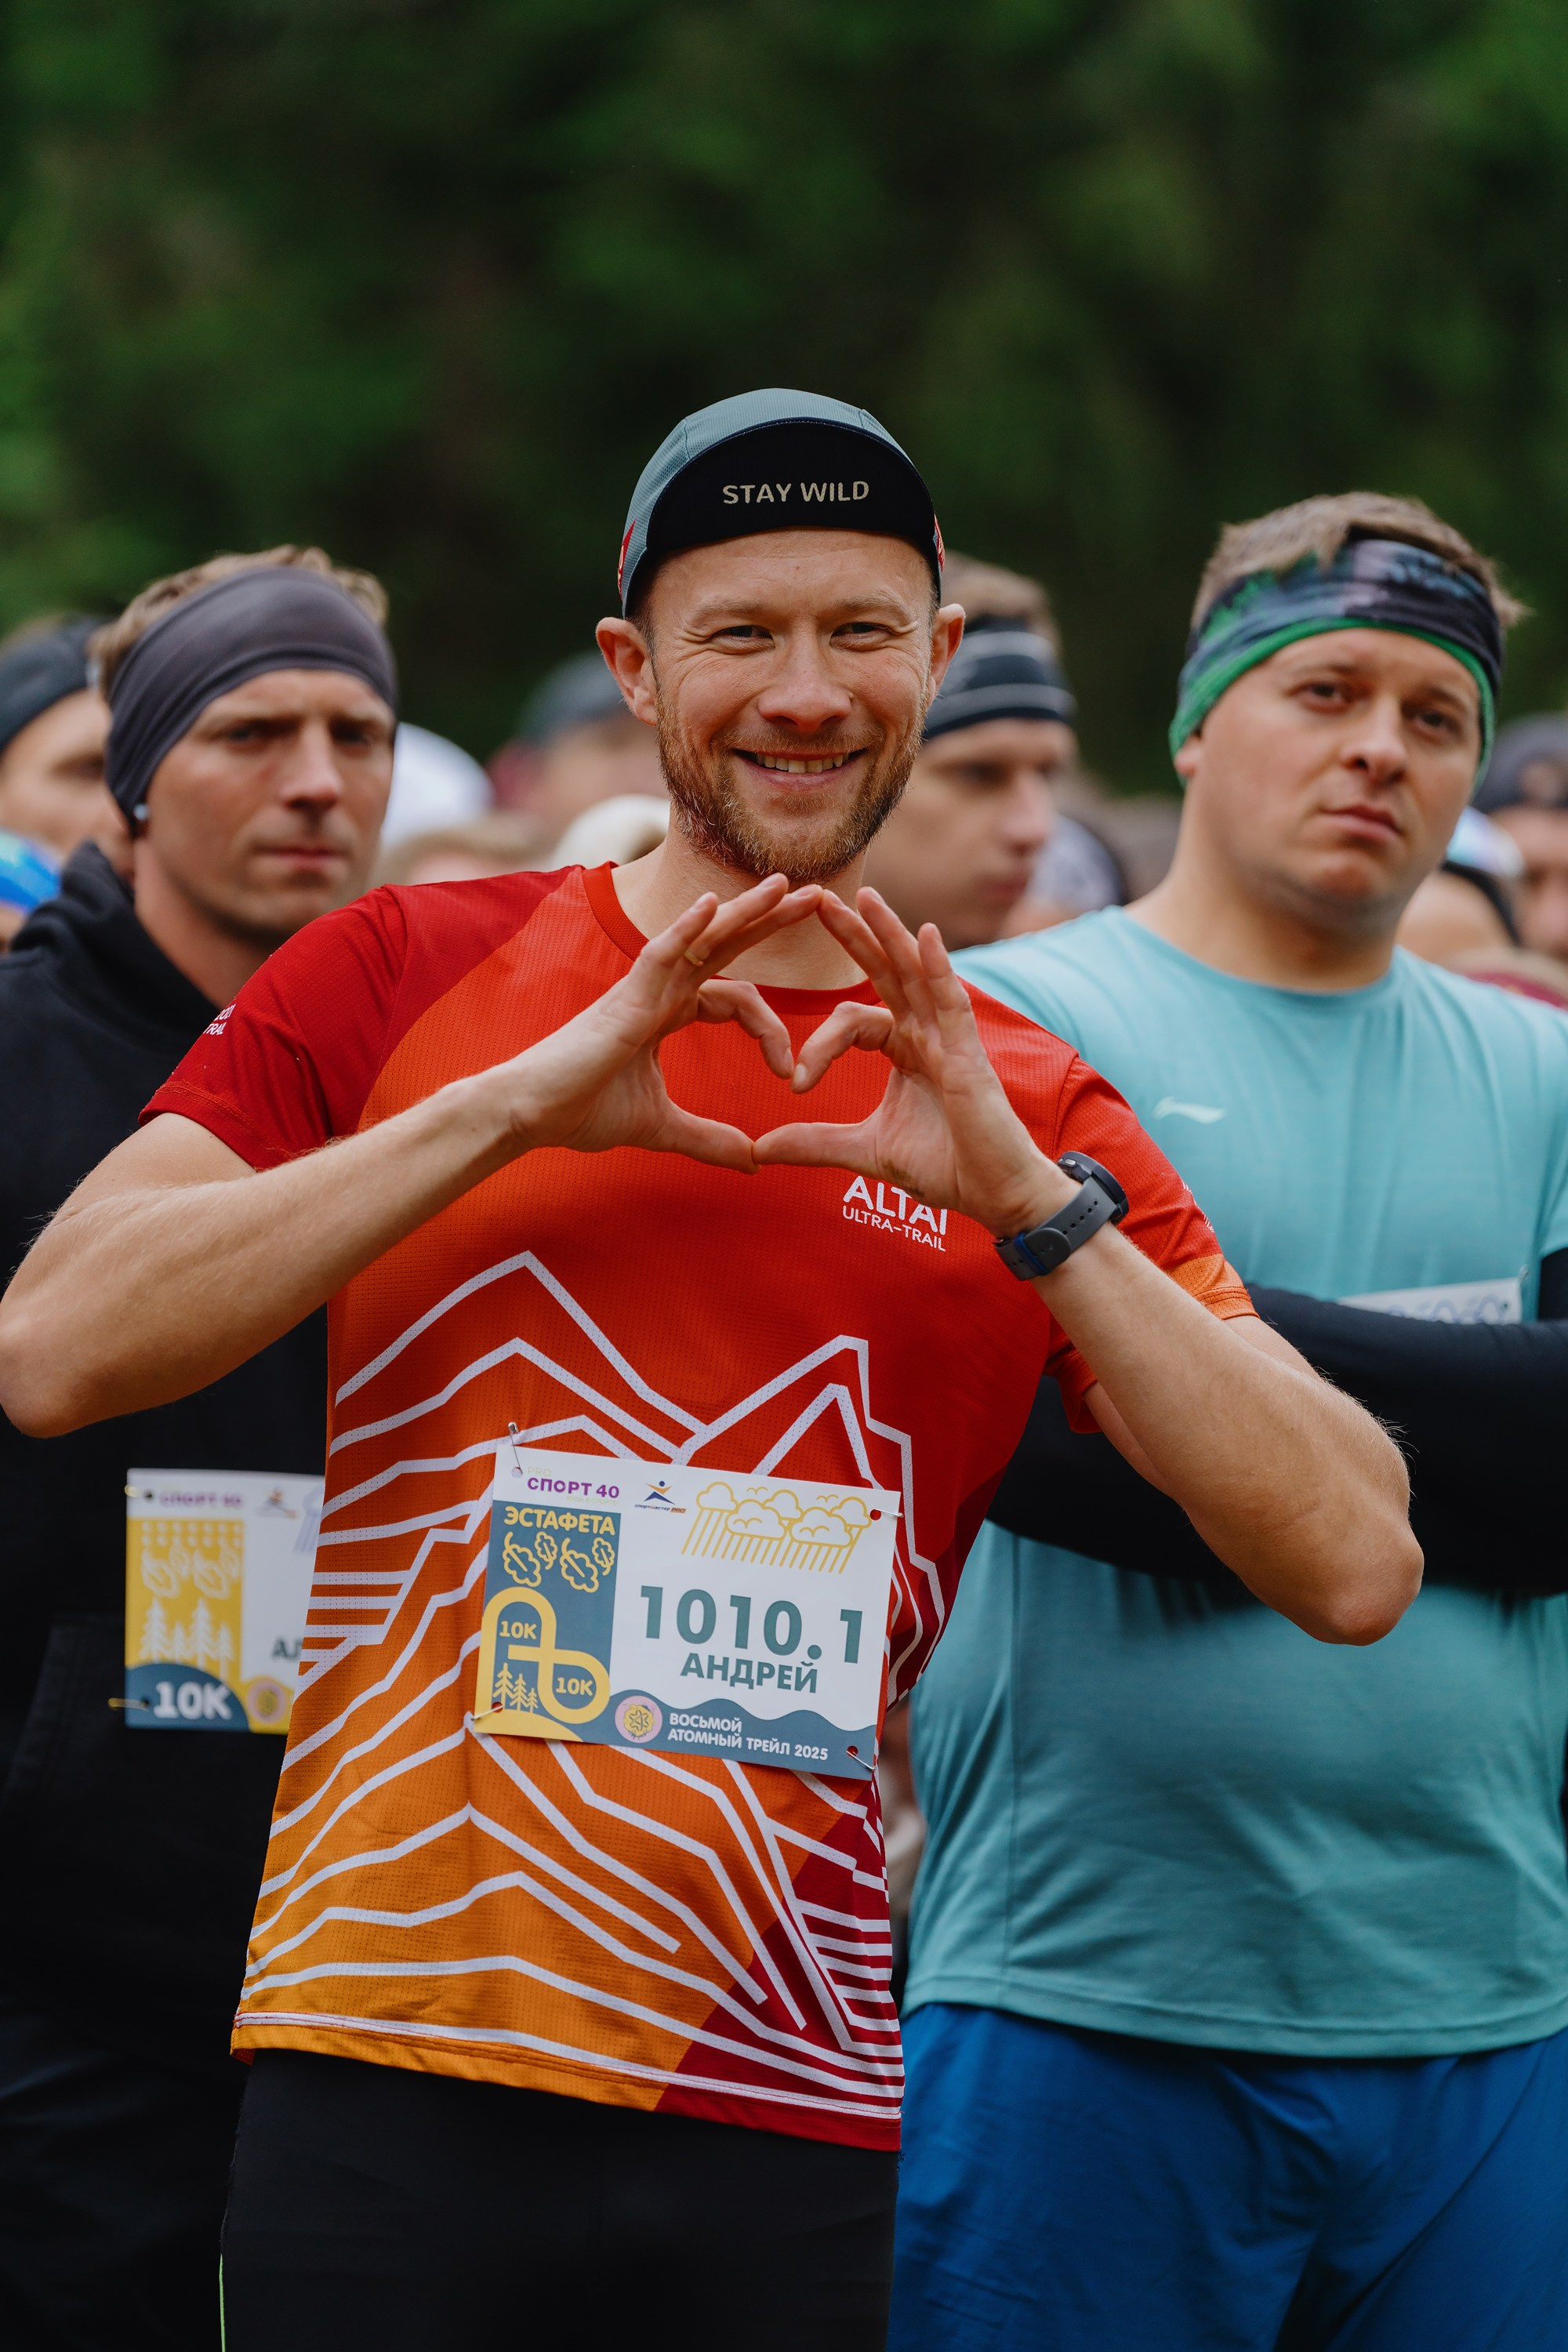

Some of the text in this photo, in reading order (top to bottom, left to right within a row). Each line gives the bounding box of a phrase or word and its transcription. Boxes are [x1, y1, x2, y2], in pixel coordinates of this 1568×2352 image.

[722, 481, 869, 504] STAY WILD
[843, 1175, 948, 1236] ALTAI
[843, 1205, 946, 1252] ULTRA-TRAIL
[527, 1477, 620, 1499] СПОРТ 40
[503, 1506, 615, 1536] ЭСТАФЕТА
[641, 1584, 862, 1664] 1010.1
[680, 1652, 818, 1694] АНДРЕЙ
[670, 1712, 742, 1733] ВОСЬМОЙ
[668, 1728, 828, 1761] АТОМНЫЙ ТРЕЙЛ 2025
